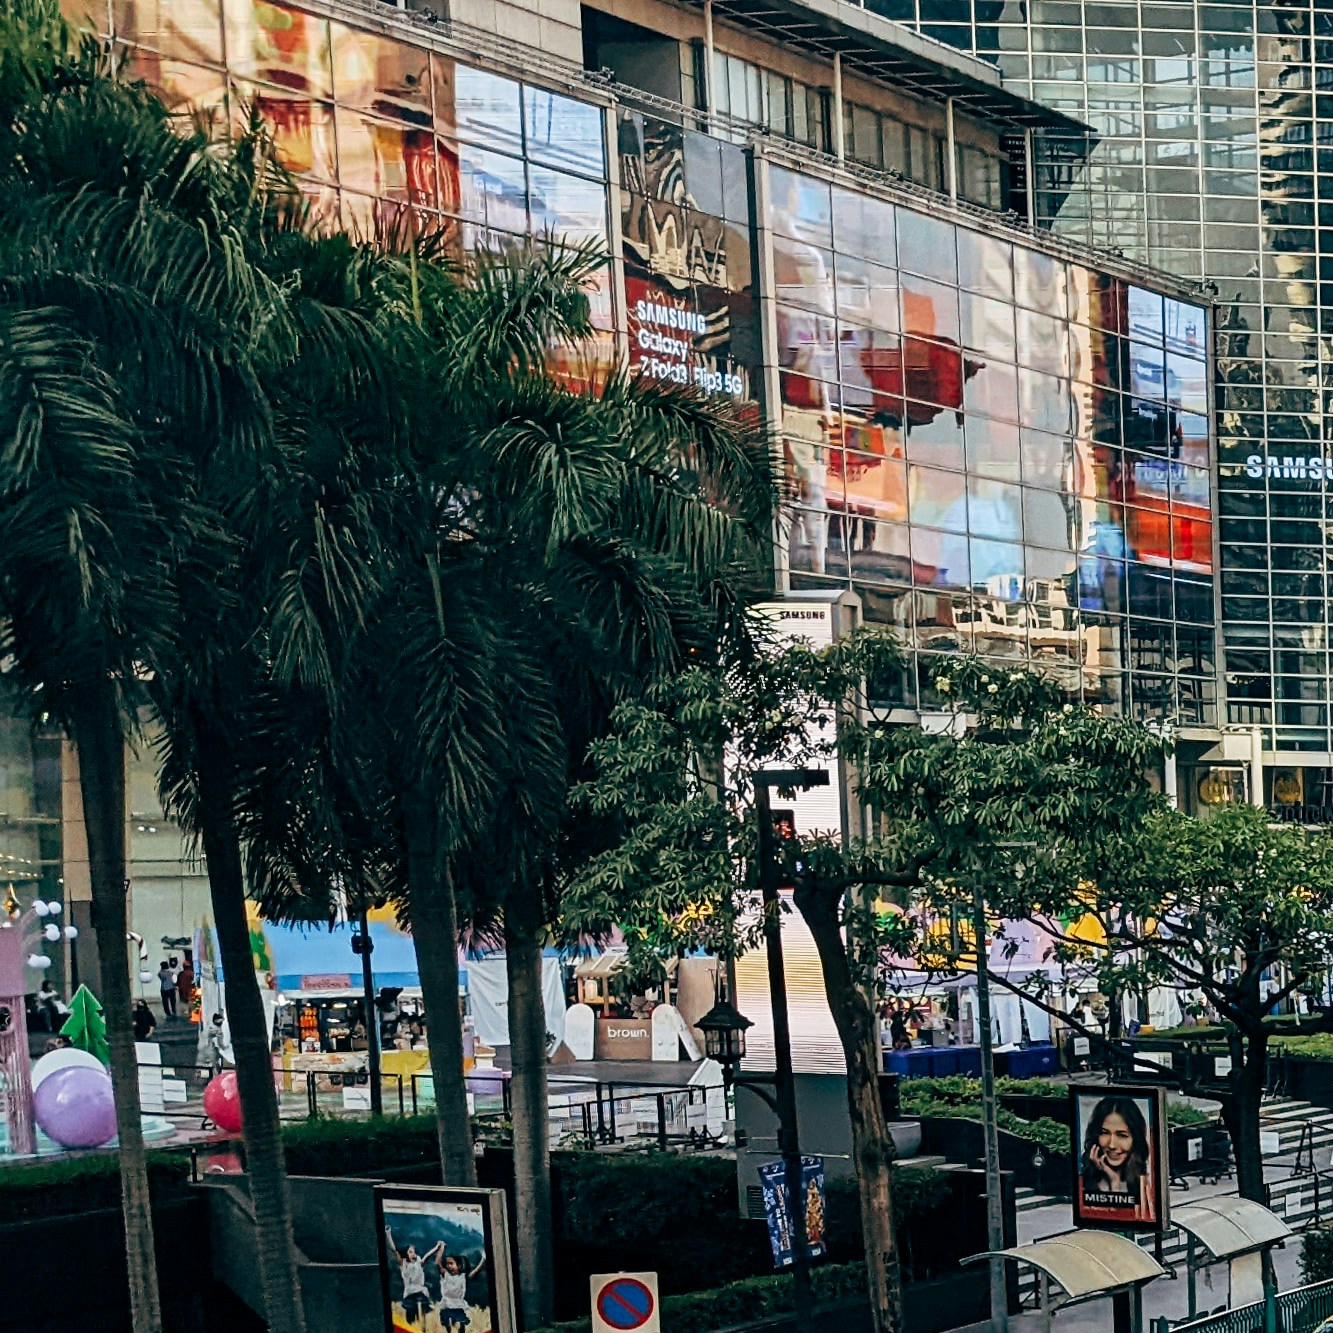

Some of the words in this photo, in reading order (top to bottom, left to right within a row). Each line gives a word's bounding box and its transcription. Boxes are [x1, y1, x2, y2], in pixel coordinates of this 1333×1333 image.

[637, 299, 706, 334] SAMSUNG
[638, 328, 688, 363] Galaxy
[651, 358, 688, 385] Fold3
[724, 373, 743, 395] 5G
[607, 1025, 650, 1038] brown.
[1084, 1193, 1136, 1204] MISTINE
